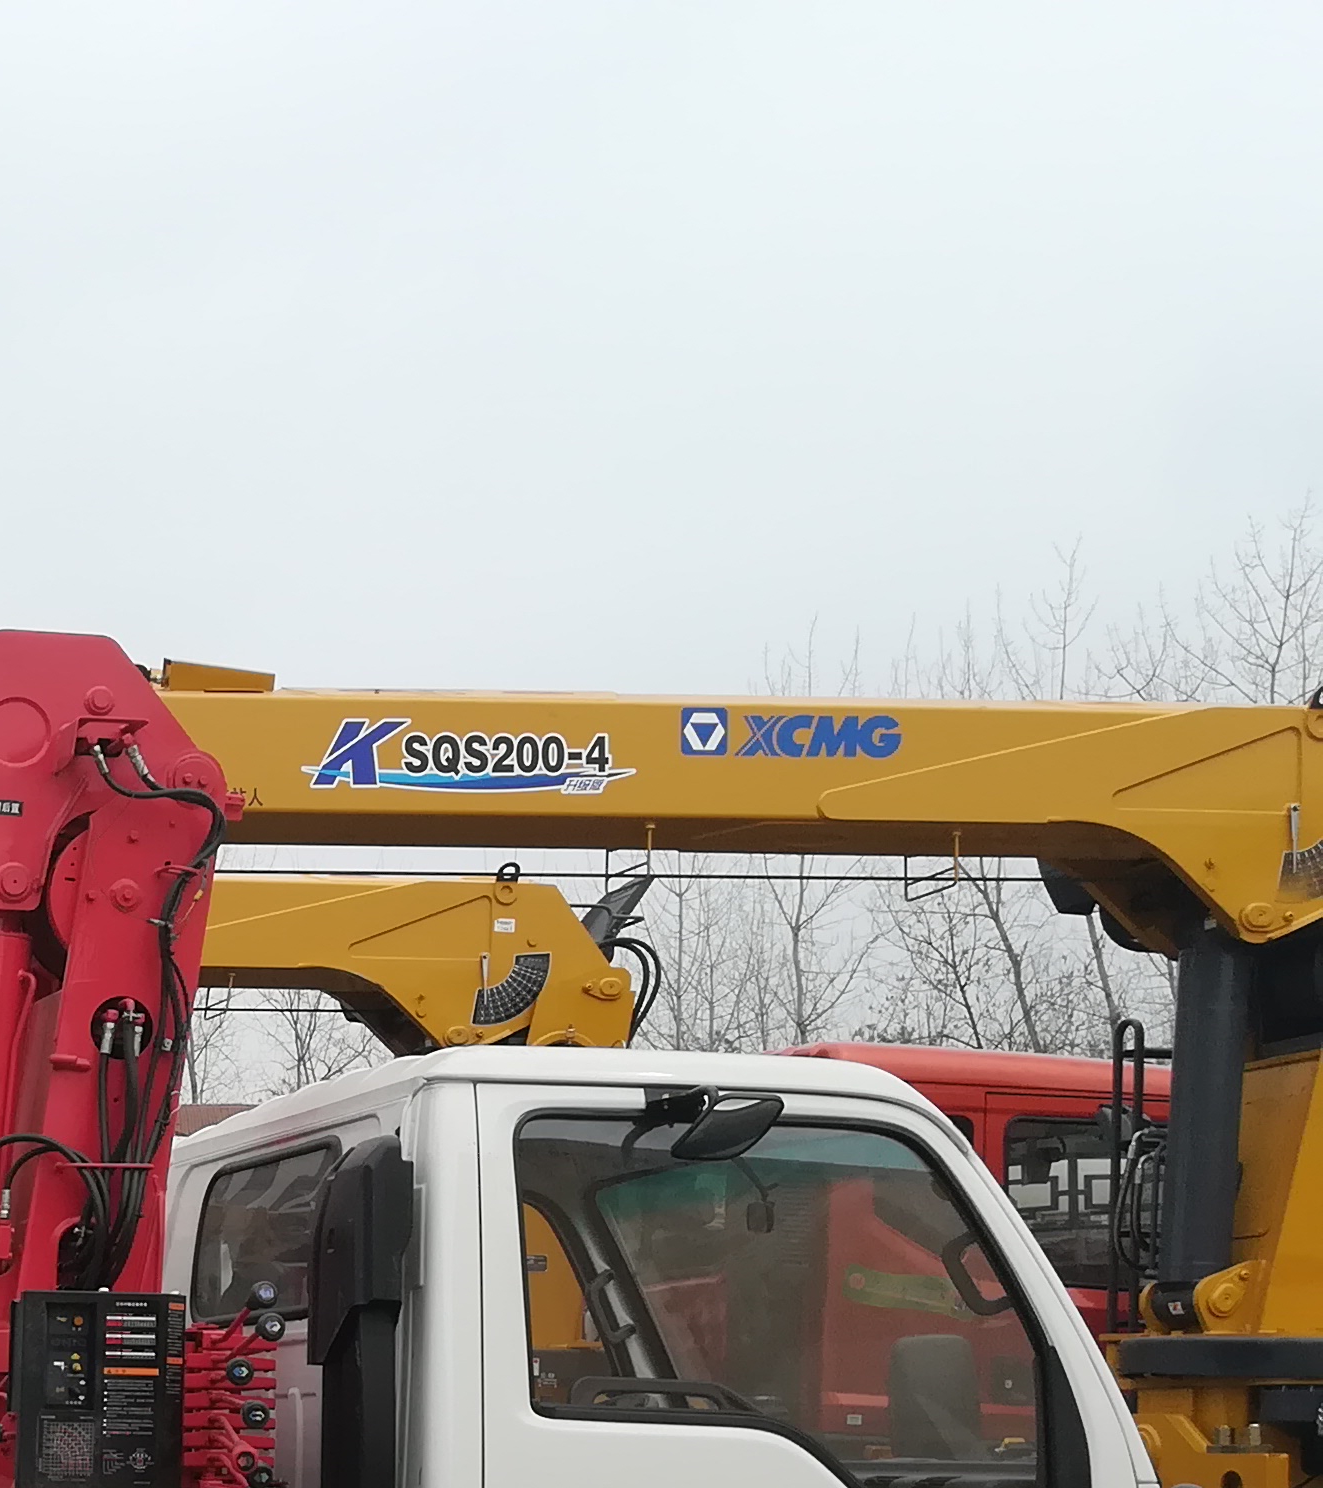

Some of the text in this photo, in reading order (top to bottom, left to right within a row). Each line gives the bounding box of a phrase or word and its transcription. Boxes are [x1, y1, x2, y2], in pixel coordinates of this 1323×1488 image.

[311, 718, 609, 788] K SQS200-4
[734, 715, 902, 758] XCMG
